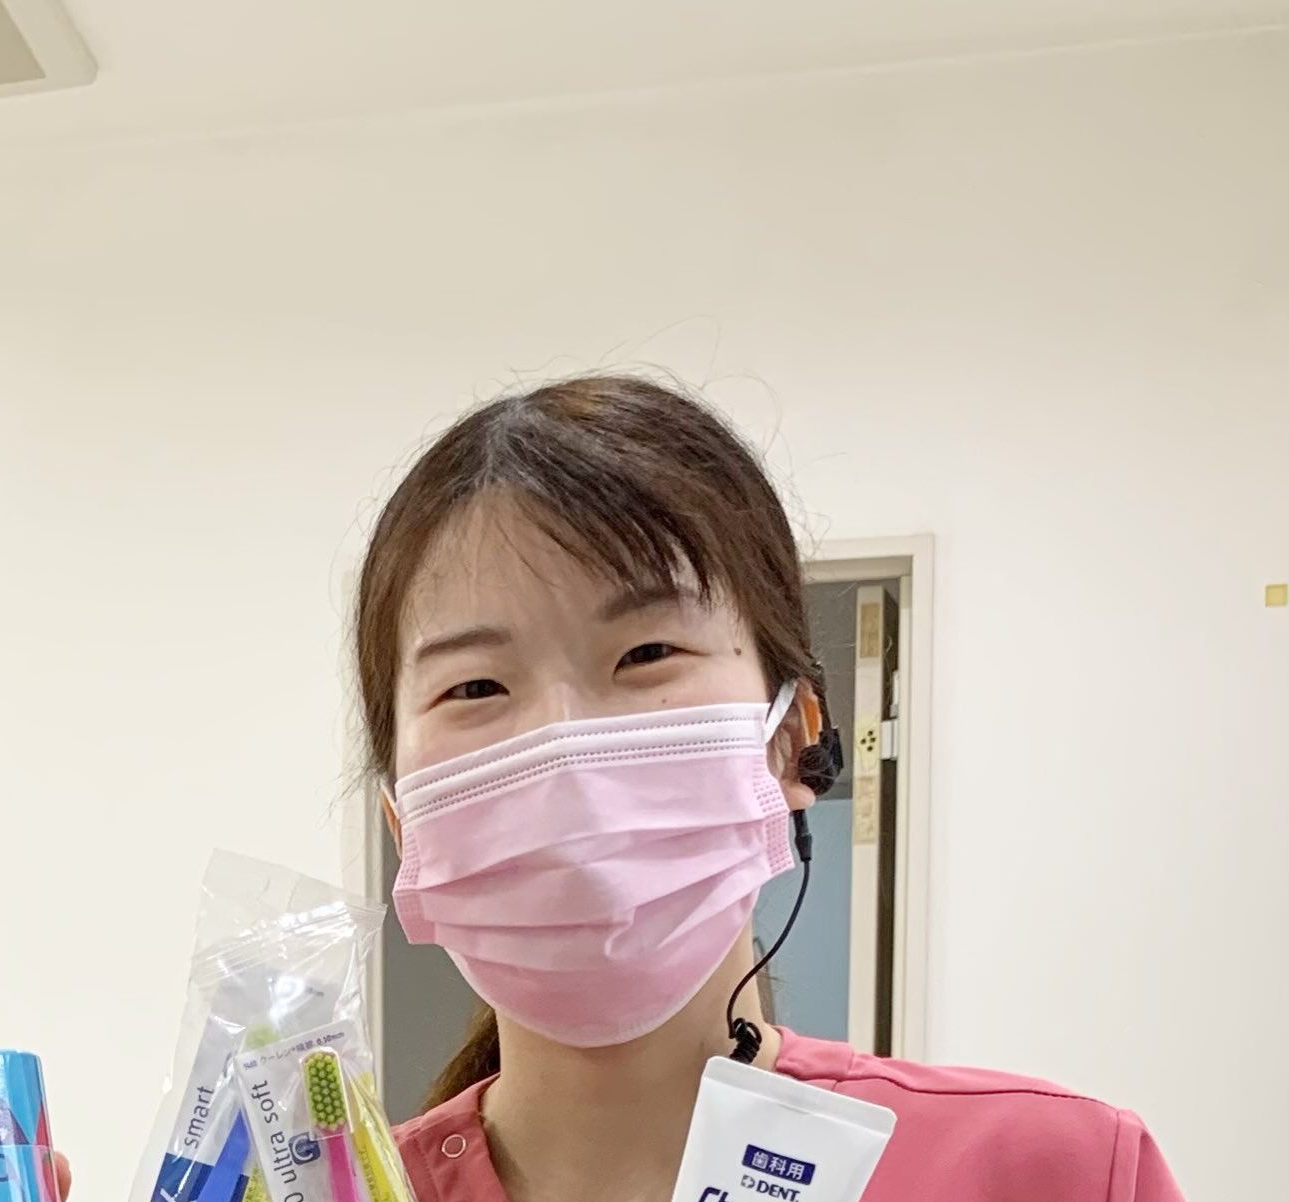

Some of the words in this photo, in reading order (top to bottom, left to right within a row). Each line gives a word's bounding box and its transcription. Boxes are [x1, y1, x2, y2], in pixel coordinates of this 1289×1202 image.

[184, 1086, 214, 1149] smart
[252, 1080, 279, 1124] soft
[270, 1131, 298, 1184] ultra
[751, 1151, 805, 1181] 歯科用
